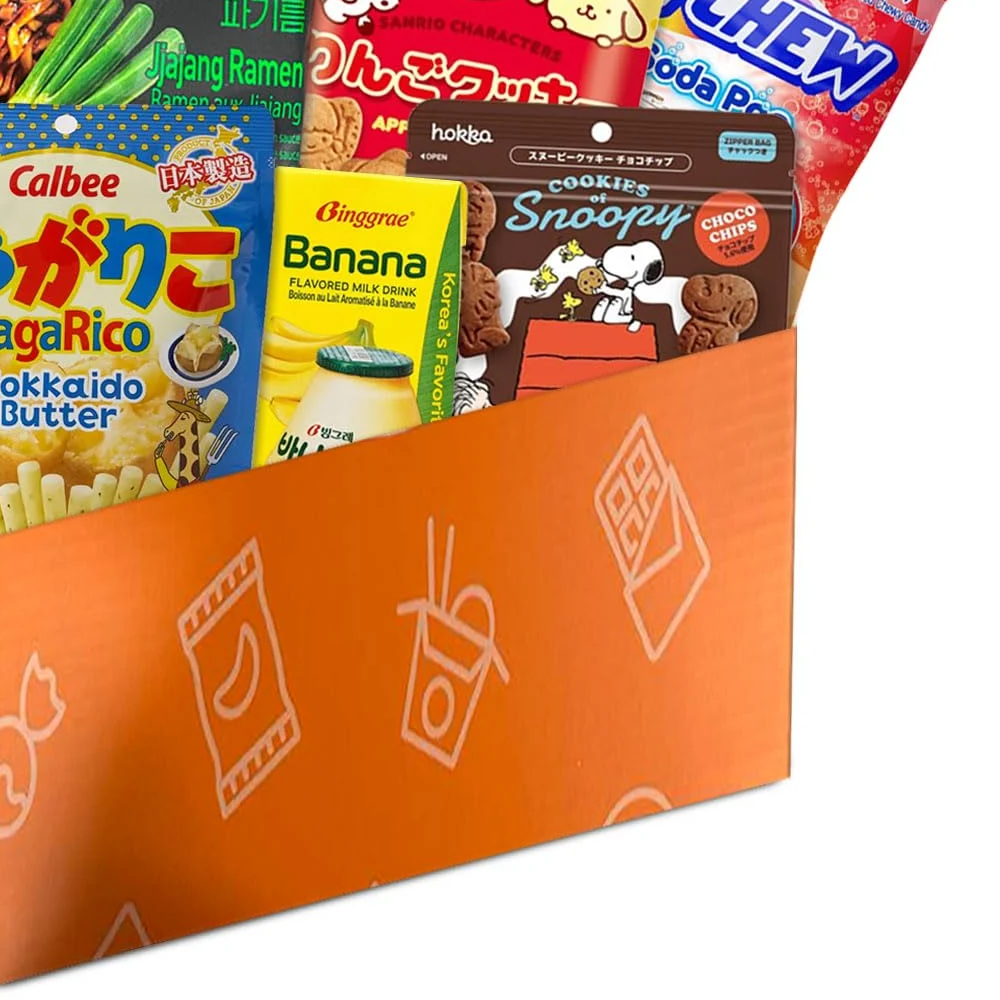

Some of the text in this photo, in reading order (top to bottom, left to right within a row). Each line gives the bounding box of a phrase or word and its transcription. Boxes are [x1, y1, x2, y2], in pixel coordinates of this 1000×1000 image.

[904, 13, 931, 34] Candy
[378, 14, 564, 64] SANRIO CHARACTERS
[145, 41, 304, 92] Jjajang Ramen
[431, 122, 494, 146] hokka
[426, 153, 448, 161] OPEN
[8, 164, 121, 199] Calbee
[547, 173, 650, 199] COOKIES
[590, 193, 607, 204] of
[315, 200, 410, 230] Binggrae
[505, 189, 692, 241] Snoopy
[701, 205, 757, 231] CHOCO
[709, 219, 758, 244] CHIPS
[283, 234, 427, 280] Banana
[288, 290, 315, 302] Boisson
[316, 294, 326, 302] au
[327, 292, 340, 304] Lait
[340, 294, 375, 307] Aromatisé
[382, 297, 388, 307] la
[389, 297, 416, 310] Banane
[289, 277, 417, 297] FLAVORED MILK DRINK
[435, 272, 457, 348] Korea's
[0, 402, 118, 429] Butter
